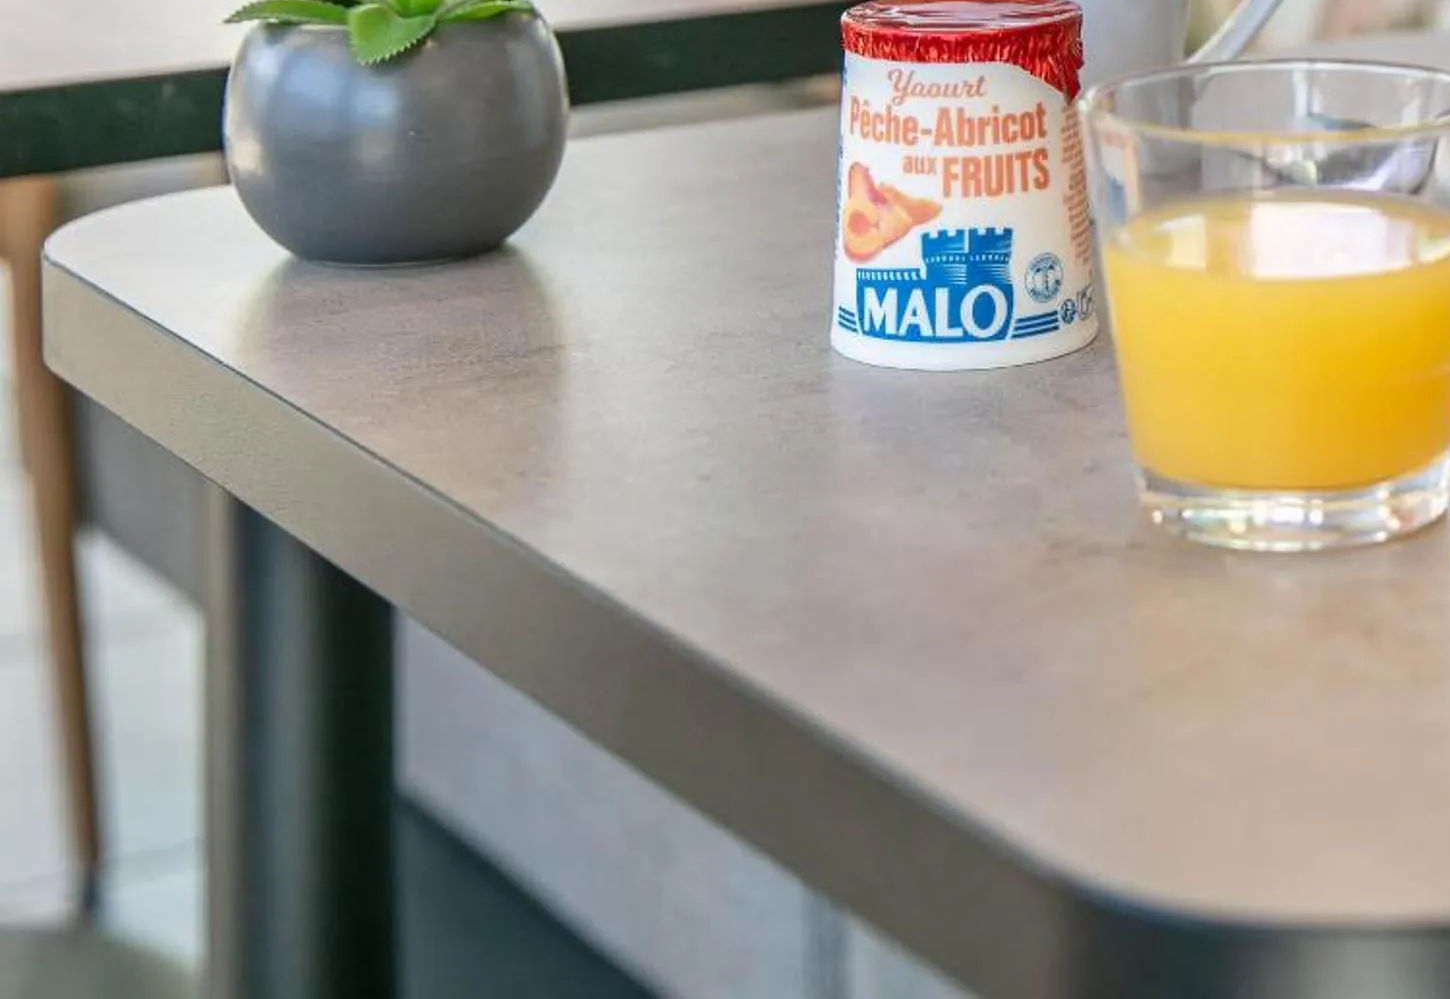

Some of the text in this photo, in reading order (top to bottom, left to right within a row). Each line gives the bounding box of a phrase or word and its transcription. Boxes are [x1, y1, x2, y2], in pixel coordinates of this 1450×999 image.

[888, 68, 986, 105] Yaourt
[850, 95, 1047, 146] Pêche-Abricot
[902, 147, 1050, 198] aux FRUITS
[863, 284, 1008, 339] MALO
